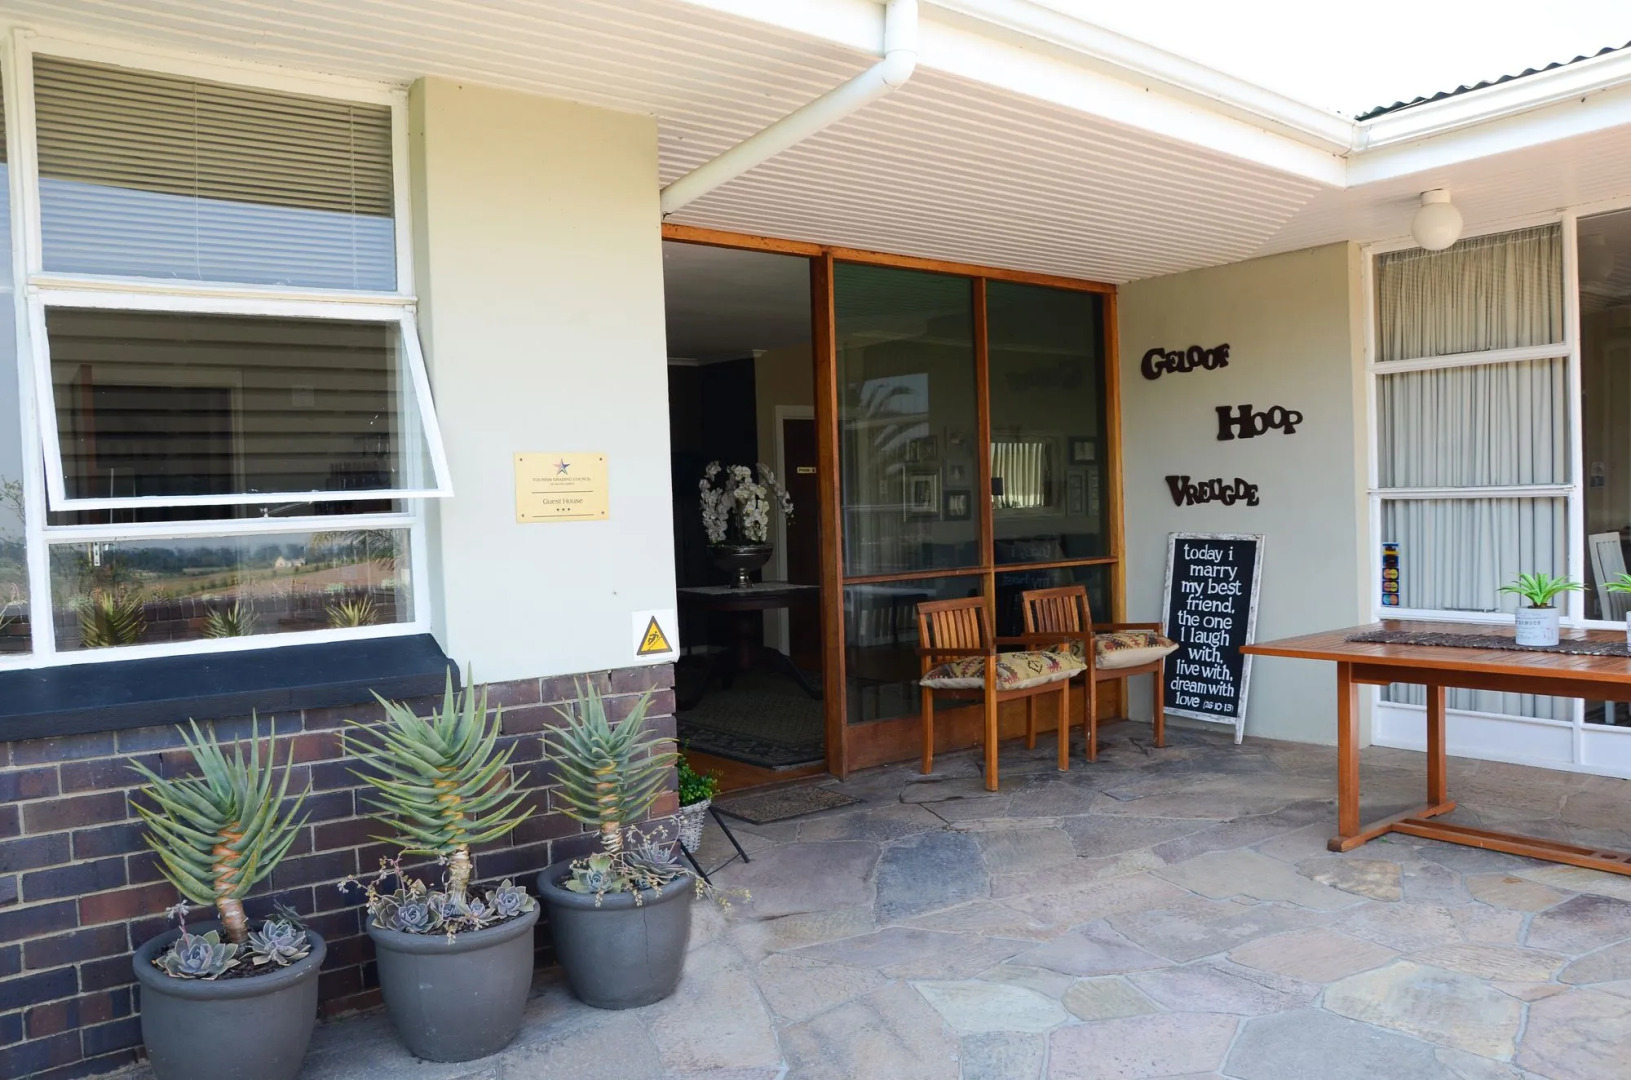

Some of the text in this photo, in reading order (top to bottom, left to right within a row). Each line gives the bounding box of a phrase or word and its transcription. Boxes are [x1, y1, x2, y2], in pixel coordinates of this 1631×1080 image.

[1216, 404, 1303, 441] HOOP
[1165, 475, 1260, 507] VREUGDE
[1183, 543, 1234, 563] today i
[1189, 564, 1238, 581] marry
[1181, 578, 1242, 597] my best
[1177, 610, 1233, 630] the one
[1190, 627, 1230, 648] laugh
[1176, 659, 1200, 676] live
[1170, 676, 1235, 698] dream with
[1175, 691, 1201, 708] love
